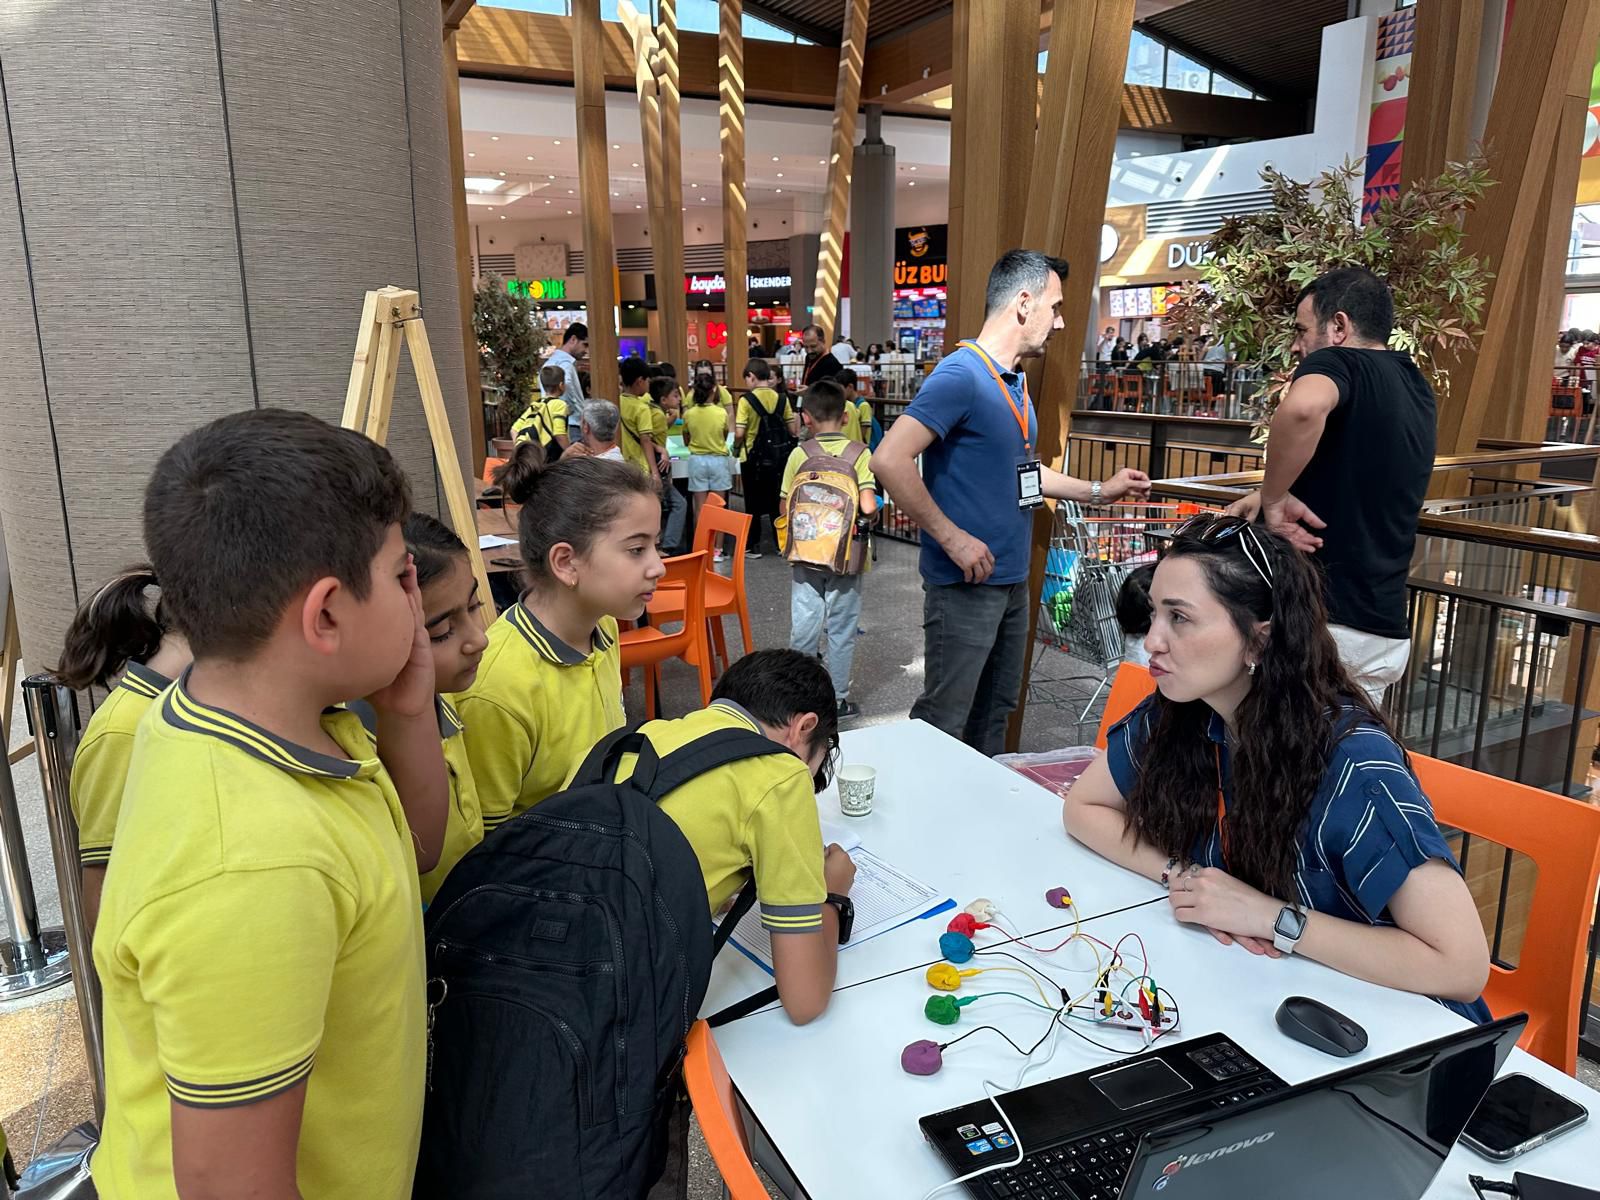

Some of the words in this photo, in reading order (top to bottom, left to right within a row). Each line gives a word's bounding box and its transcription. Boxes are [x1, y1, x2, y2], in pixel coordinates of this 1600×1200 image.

[1168, 241, 1212, 268] DÜ
[690, 274, 726, 295] baydö
[750, 275, 792, 289] İSKENDER
[894, 260, 918, 285] ÜZ
[920, 264, 948, 284] BU
[541, 276, 566, 300] PİDE
[1183, 1131, 1275, 1169] lenovo
